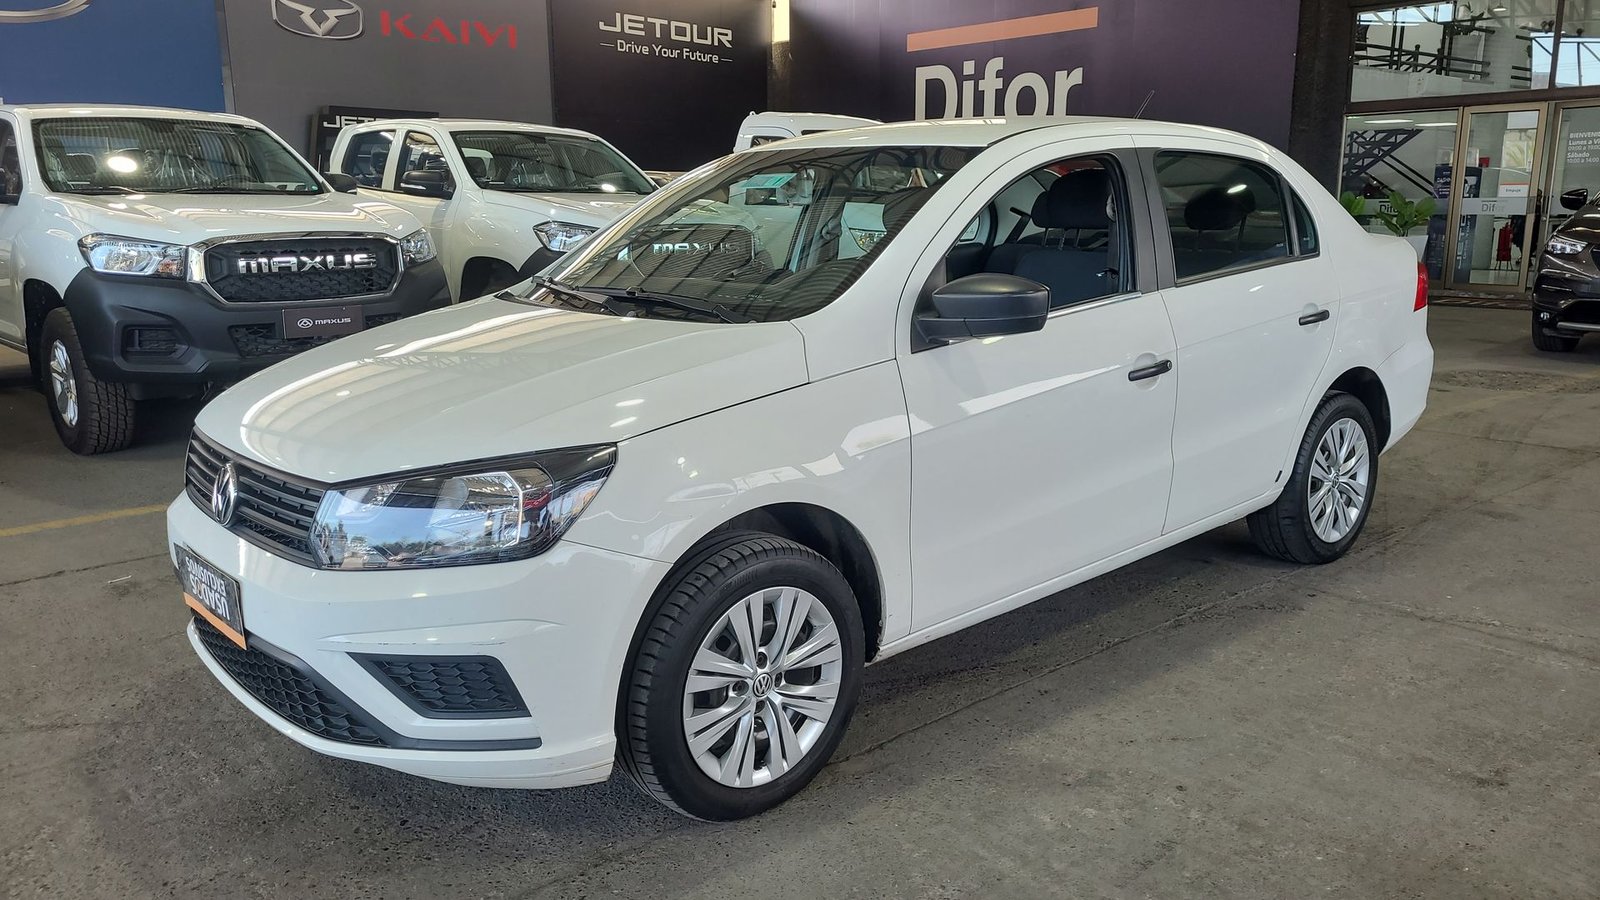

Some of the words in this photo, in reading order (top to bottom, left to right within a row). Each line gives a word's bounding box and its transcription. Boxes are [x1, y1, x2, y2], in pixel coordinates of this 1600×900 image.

[599, 12, 733, 48] JETOUR
[617, 39, 649, 55] Drive
[652, 44, 680, 58] Your
[683, 48, 719, 63] Future
[914, 57, 1083, 121] Difor
[238, 253, 376, 274] MAXUS
[314, 317, 351, 325] MAXUS
[189, 573, 230, 621] USADOS
